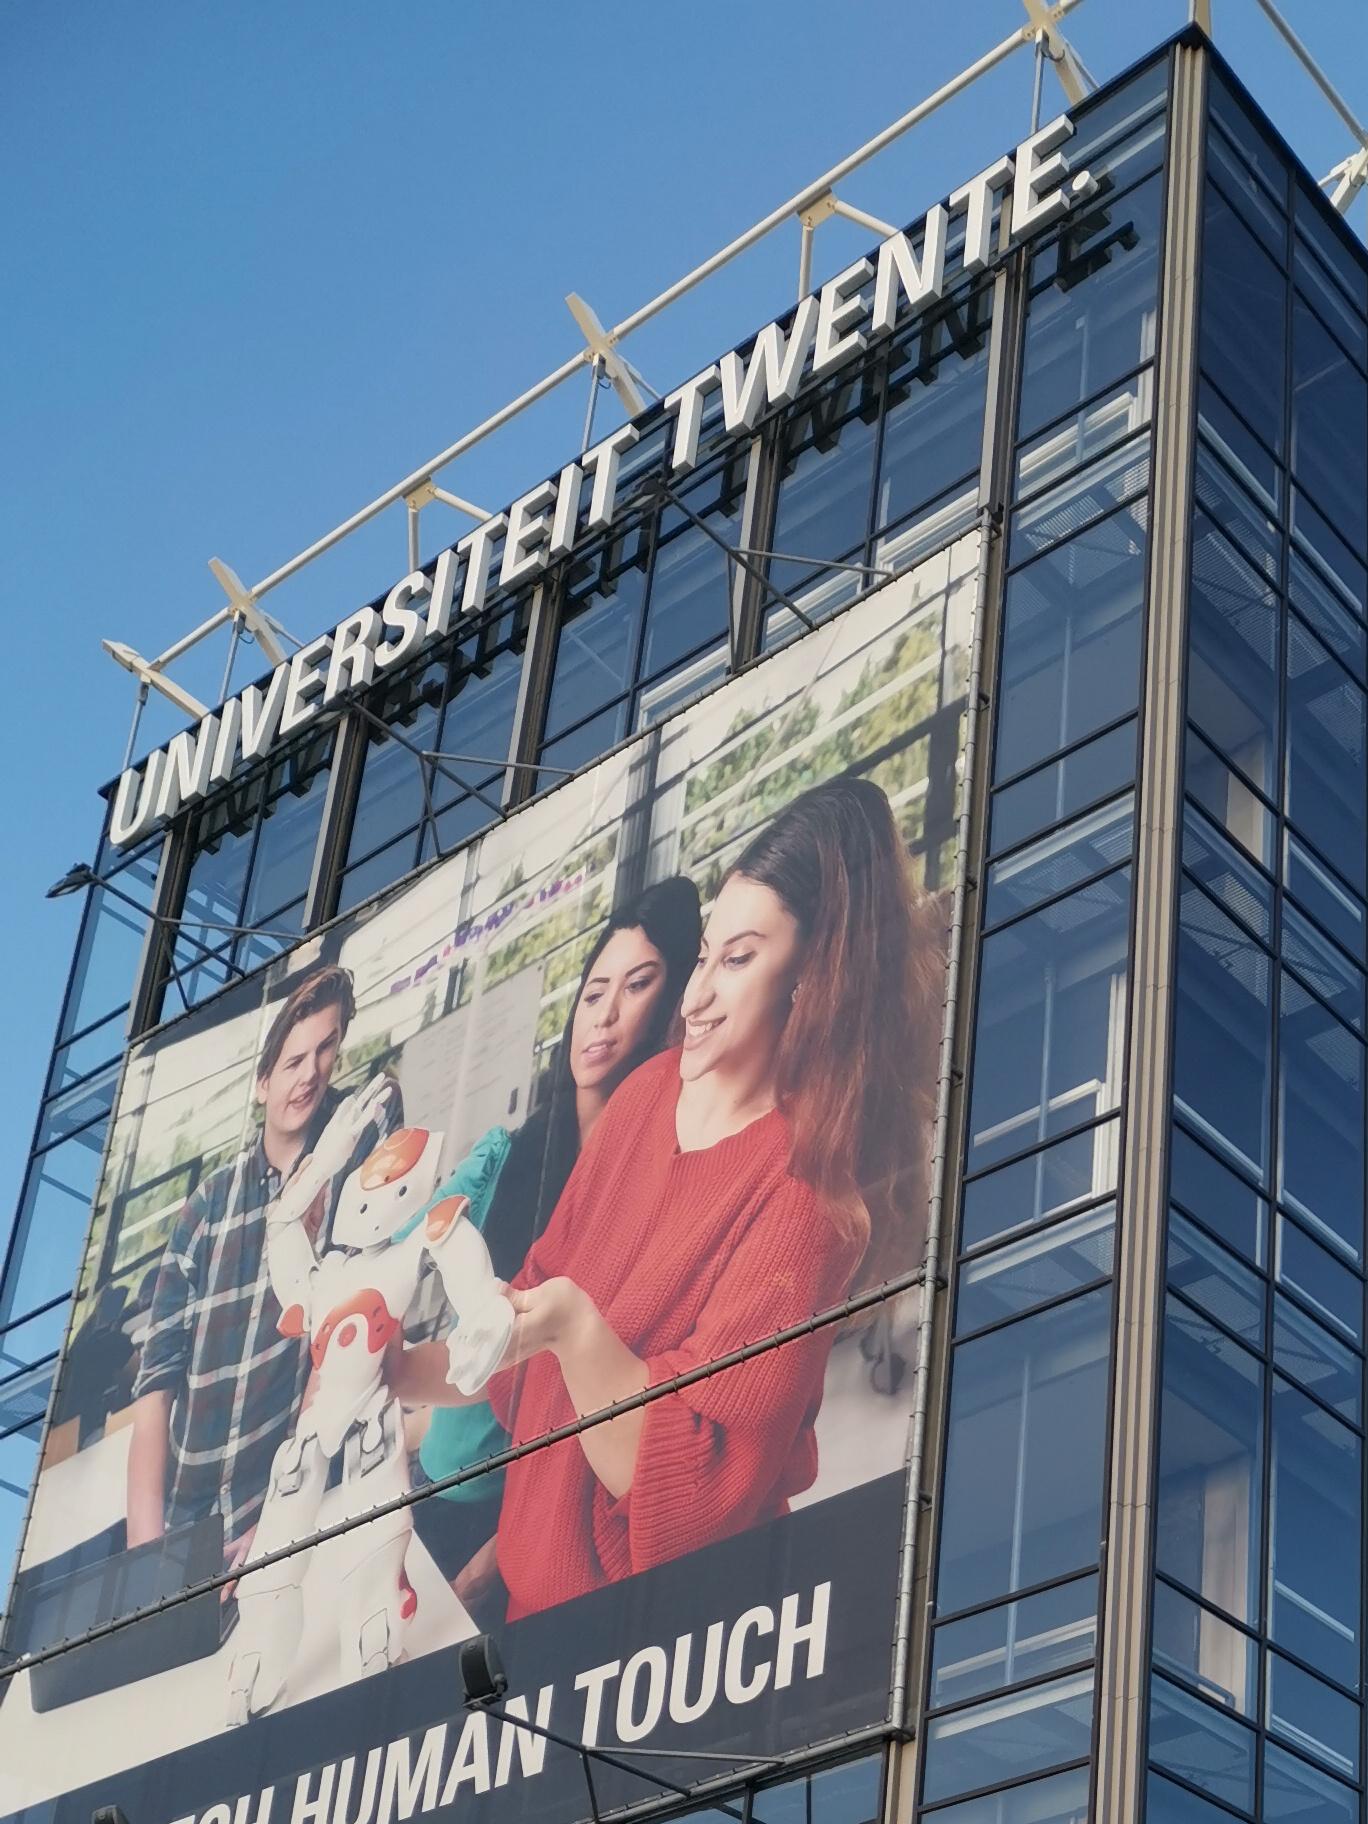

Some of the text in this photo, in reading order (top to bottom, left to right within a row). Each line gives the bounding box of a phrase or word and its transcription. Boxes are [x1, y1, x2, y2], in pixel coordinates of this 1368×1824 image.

[110, 113, 1098, 848] UNIVERSITEIT TWENTE.
[574, 1581, 831, 1748] TOUCH
